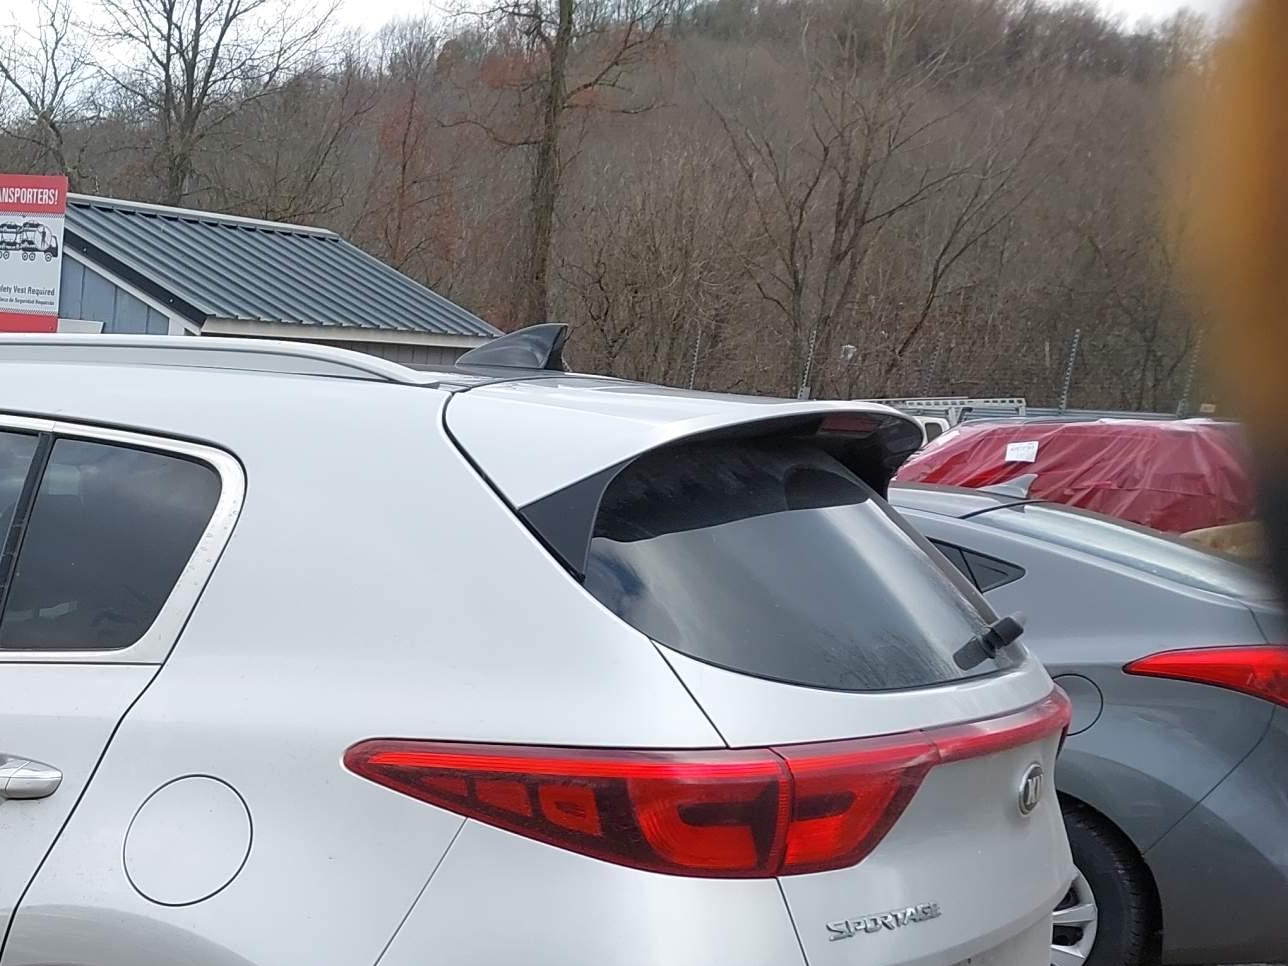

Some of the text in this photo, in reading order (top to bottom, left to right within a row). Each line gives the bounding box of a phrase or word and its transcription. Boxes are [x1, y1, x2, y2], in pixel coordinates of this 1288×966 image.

[13, 285, 27, 294] Vest
[28, 286, 55, 296] Required
[826, 903, 942, 942] SPORTAGE
